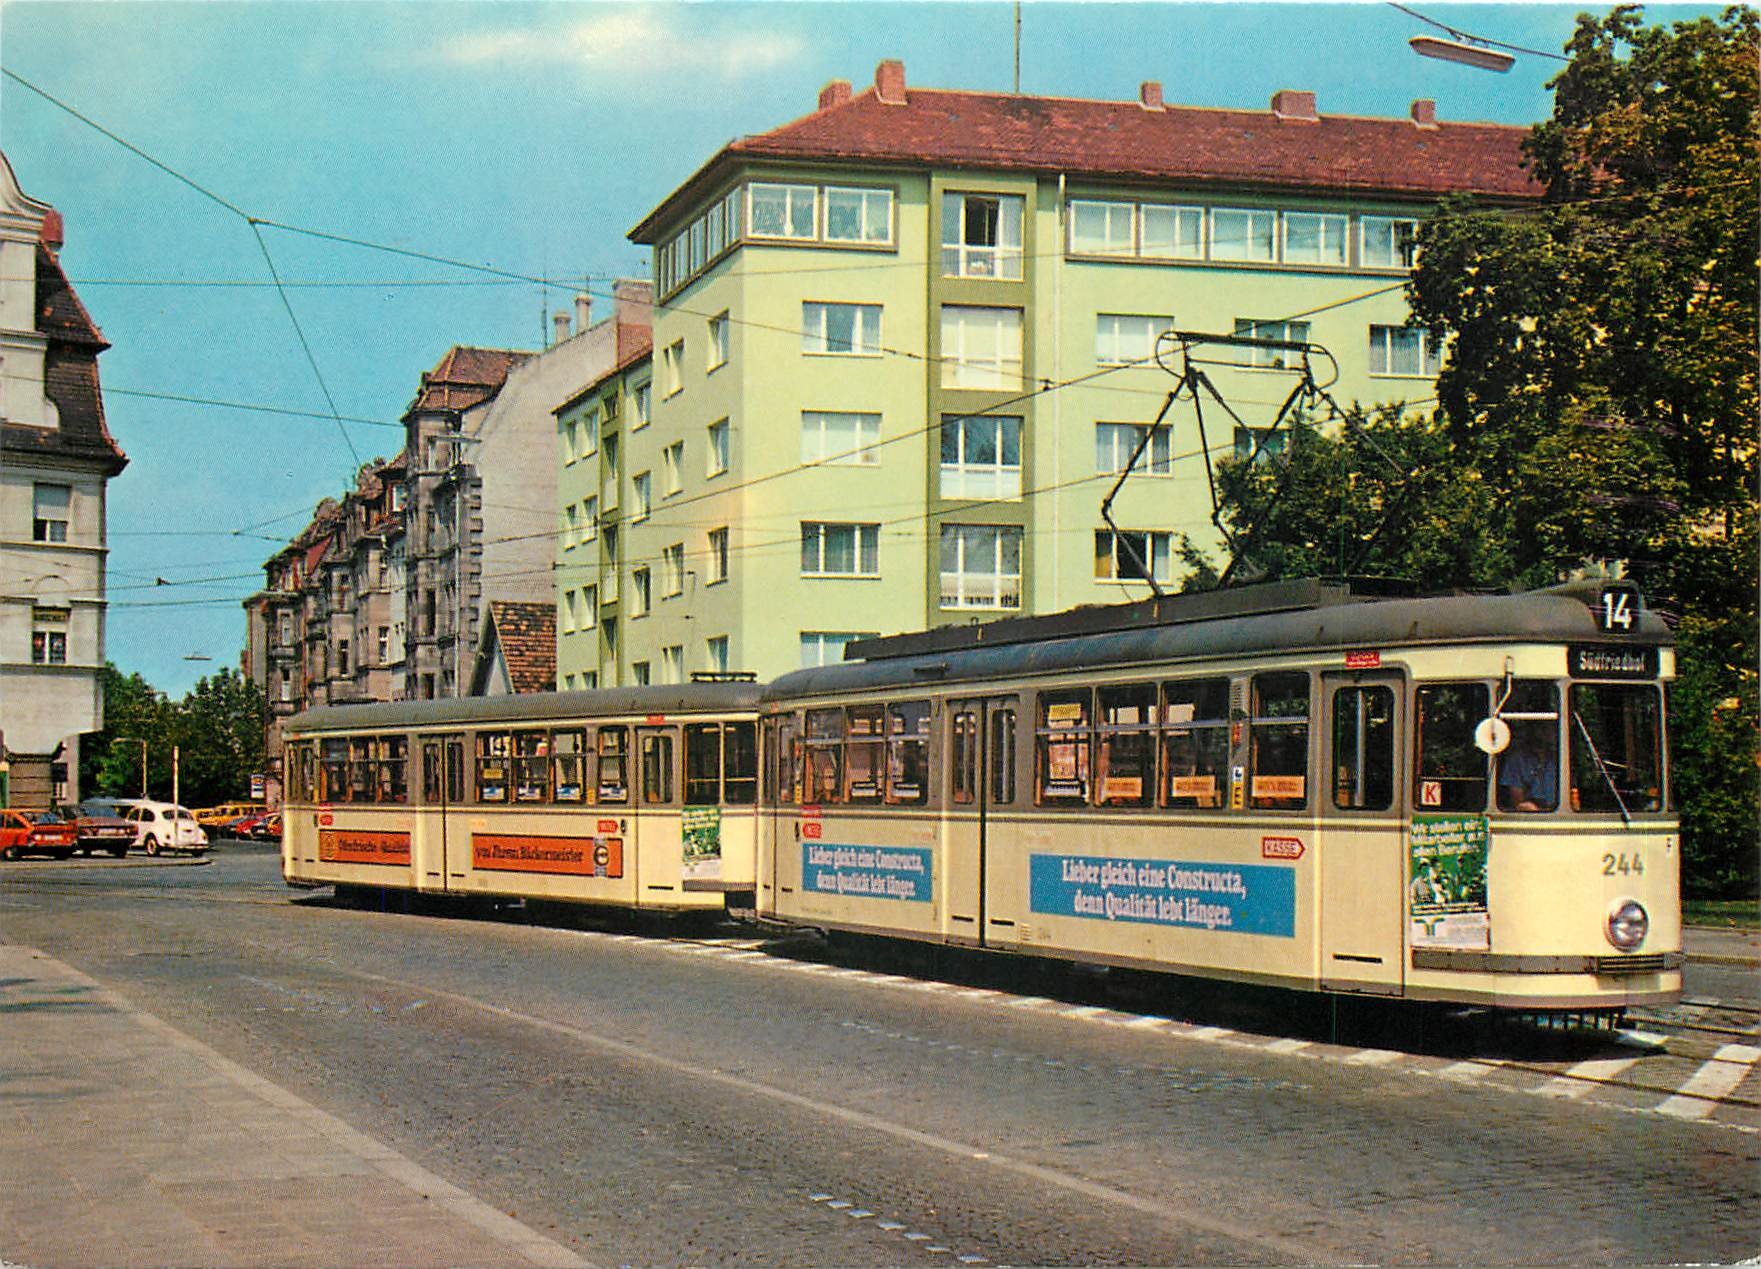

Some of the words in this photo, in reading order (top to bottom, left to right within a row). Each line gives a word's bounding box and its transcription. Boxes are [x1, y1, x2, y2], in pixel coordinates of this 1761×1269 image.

[1603, 593, 1632, 629] 14
[1580, 651, 1645, 672] Südfriedhof
[1424, 784, 1438, 804] K
[1266, 839, 1299, 856] KASSE
[809, 846, 833, 865] Lieber
[834, 847, 857, 869] gleich
[858, 848, 876, 868] eine
[876, 849, 924, 876] Constructa,
[1602, 852, 1644, 876] 244
[817, 870, 837, 889] denn
[837, 871, 870, 894] Qualität
[870, 873, 886, 893] lebt
[1062, 859, 1101, 884] Lieber
[1101, 861, 1137, 889] gleich
[1138, 864, 1166, 888] eine
[1168, 864, 1247, 899] Constructa,
[1074, 889, 1104, 914] denn
[1106, 892, 1157, 921] Qualität
[1159, 895, 1183, 921] lebt
[1186, 898, 1232, 929] länger.
